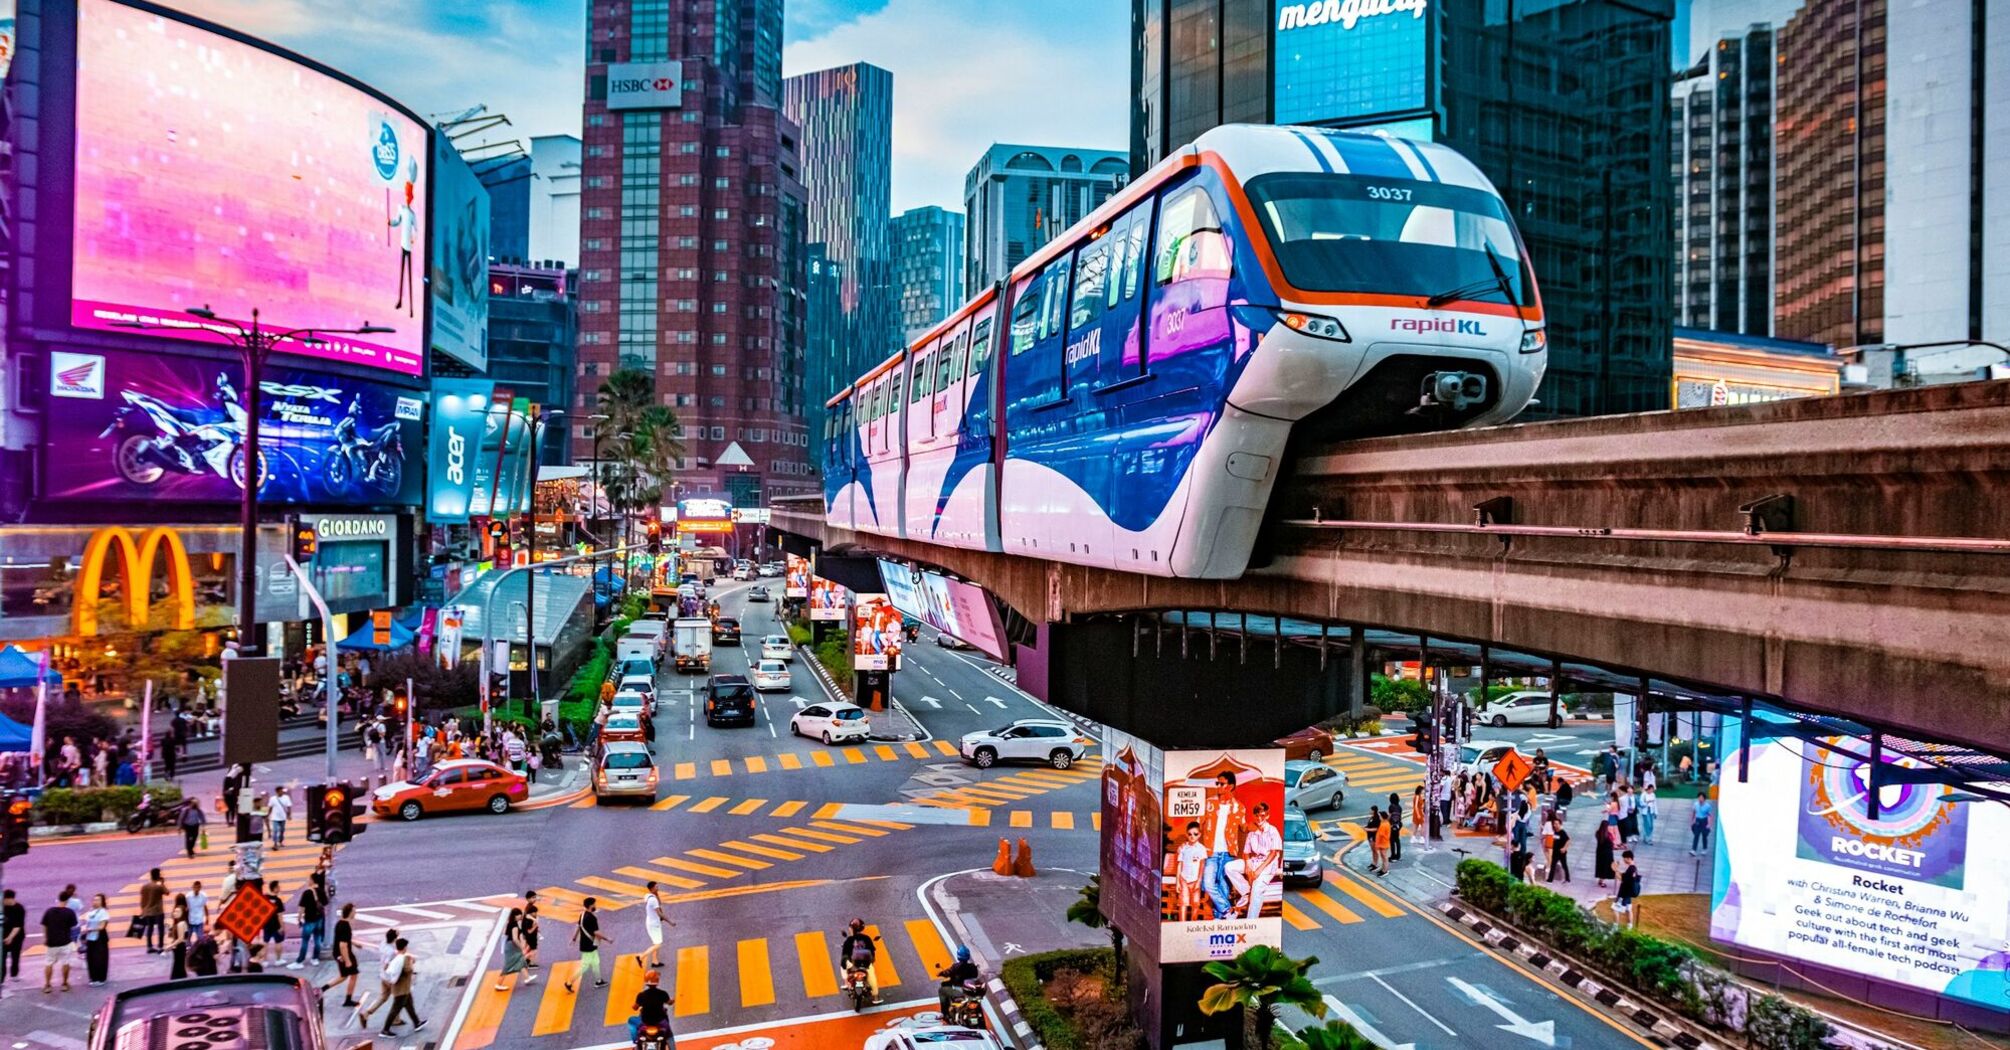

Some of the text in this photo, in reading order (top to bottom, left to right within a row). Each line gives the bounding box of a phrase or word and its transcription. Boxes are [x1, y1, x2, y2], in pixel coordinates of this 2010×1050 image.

[611, 79, 652, 93] HSBC
[1366, 186, 1412, 201] 3037
[1167, 307, 1187, 335] 3037
[1390, 317, 1487, 336] rapidKL
[1065, 327, 1101, 369] rapidKL
[447, 425, 465, 485] acer
[318, 518, 386, 537] GIORDANO
[1174, 803, 1200, 815] RM59
[1832, 836, 1926, 867] ROCKET
[1852, 875, 1904, 895] Rocket
[1787, 879, 1808, 888] with
[1811, 881, 1857, 899] Christina
[1904, 901, 1947, 917] Brianna
[1950, 910, 1969, 922] Wu
[1814, 895, 1938, 929] & Simone de Rochefort
[1210, 933, 1247, 945] max
[1795, 904, 1960, 949] Geek out about tech and geek
[1796, 920, 1957, 962] culture with the first and most
[1788, 931, 1963, 976] popular all-female tech podcast.
